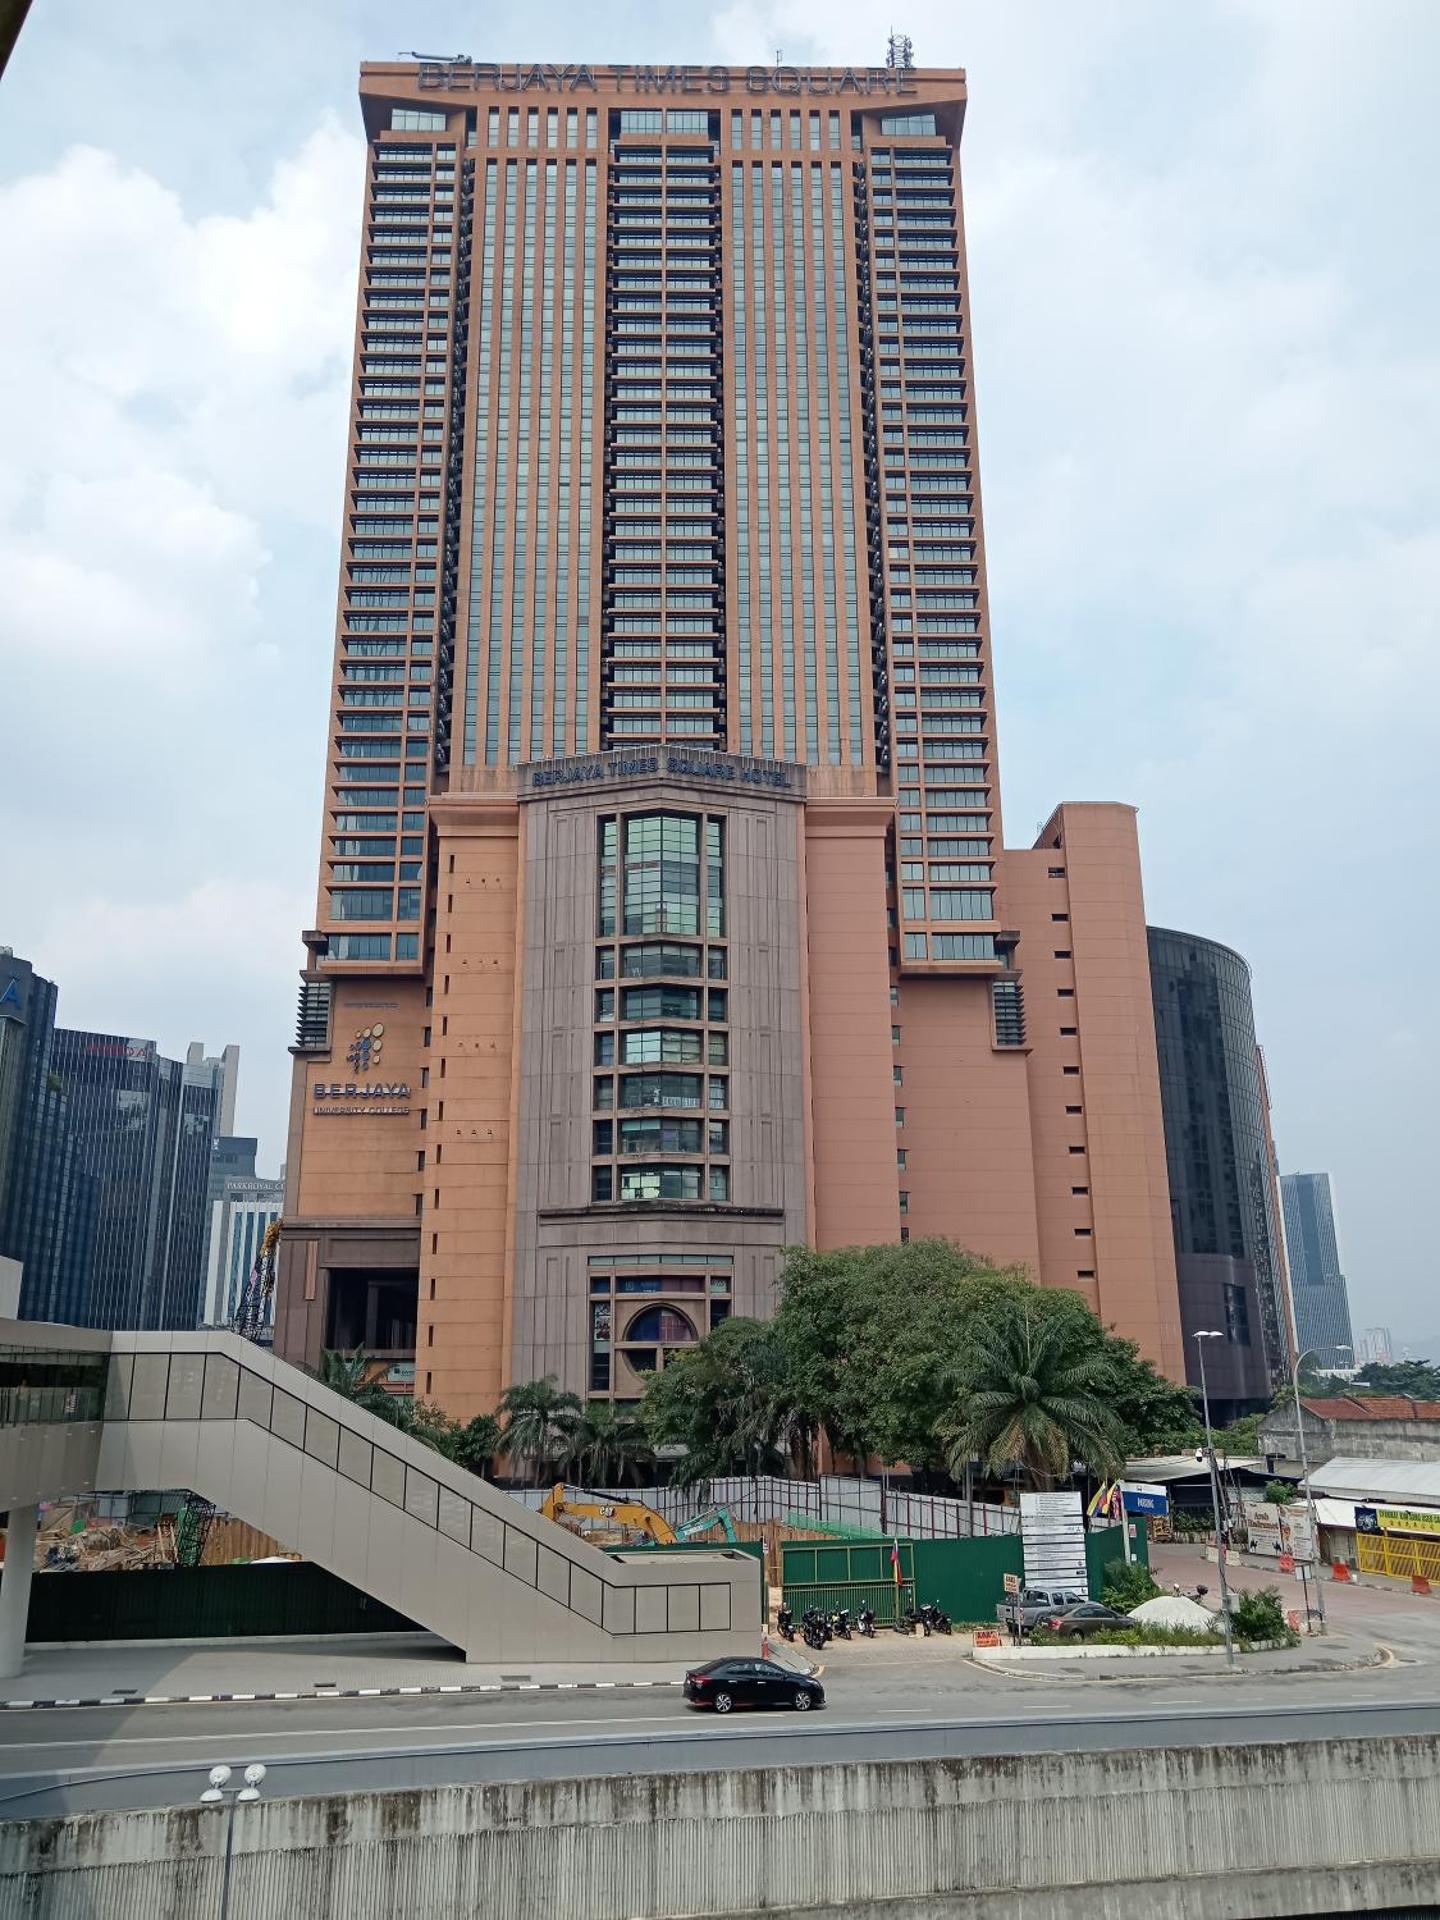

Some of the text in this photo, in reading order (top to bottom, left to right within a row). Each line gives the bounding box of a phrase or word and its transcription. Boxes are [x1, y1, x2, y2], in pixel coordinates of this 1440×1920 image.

[418, 62, 917, 97] BERJAYA TIMES SQUARE
[531, 757, 792, 788] BERJAYA TIMES SQUARE HOTEL
[313, 1083, 411, 1099] BERJAYA
[313, 1106, 409, 1116] UNIVERSITY COLLEGE
